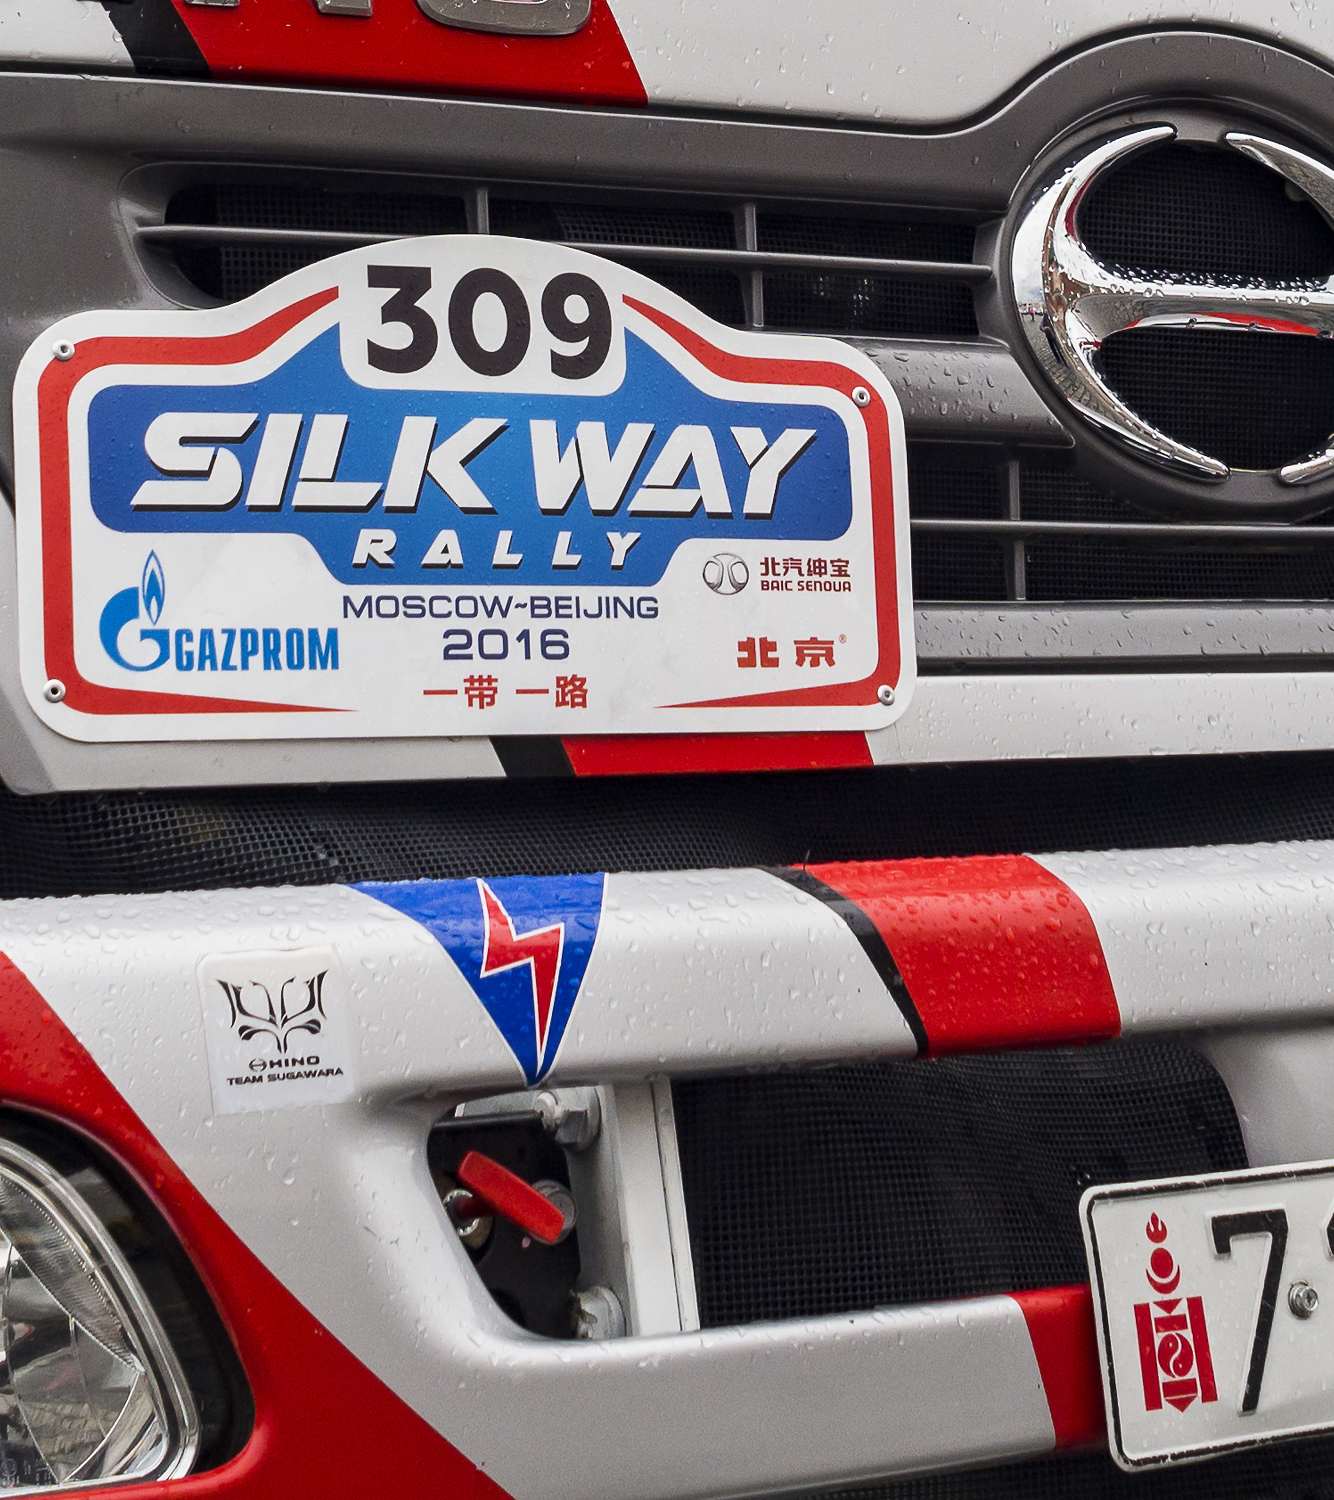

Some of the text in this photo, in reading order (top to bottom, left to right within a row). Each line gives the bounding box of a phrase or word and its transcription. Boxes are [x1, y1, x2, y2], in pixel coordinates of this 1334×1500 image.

[365, 264, 612, 380] 309
[131, 411, 817, 520] SILK WAY
[352, 528, 641, 570] RALLY
[759, 556, 851, 578] 北汽绅宝
[760, 580, 793, 592] BAIC
[174, 627, 339, 672] GAZPROM
[442, 628, 570, 660] 2016
[737, 636, 836, 668] 北京
[227, 1067, 344, 1086] TEAM SUGAWARA
[269, 1055, 320, 1069] HINO
